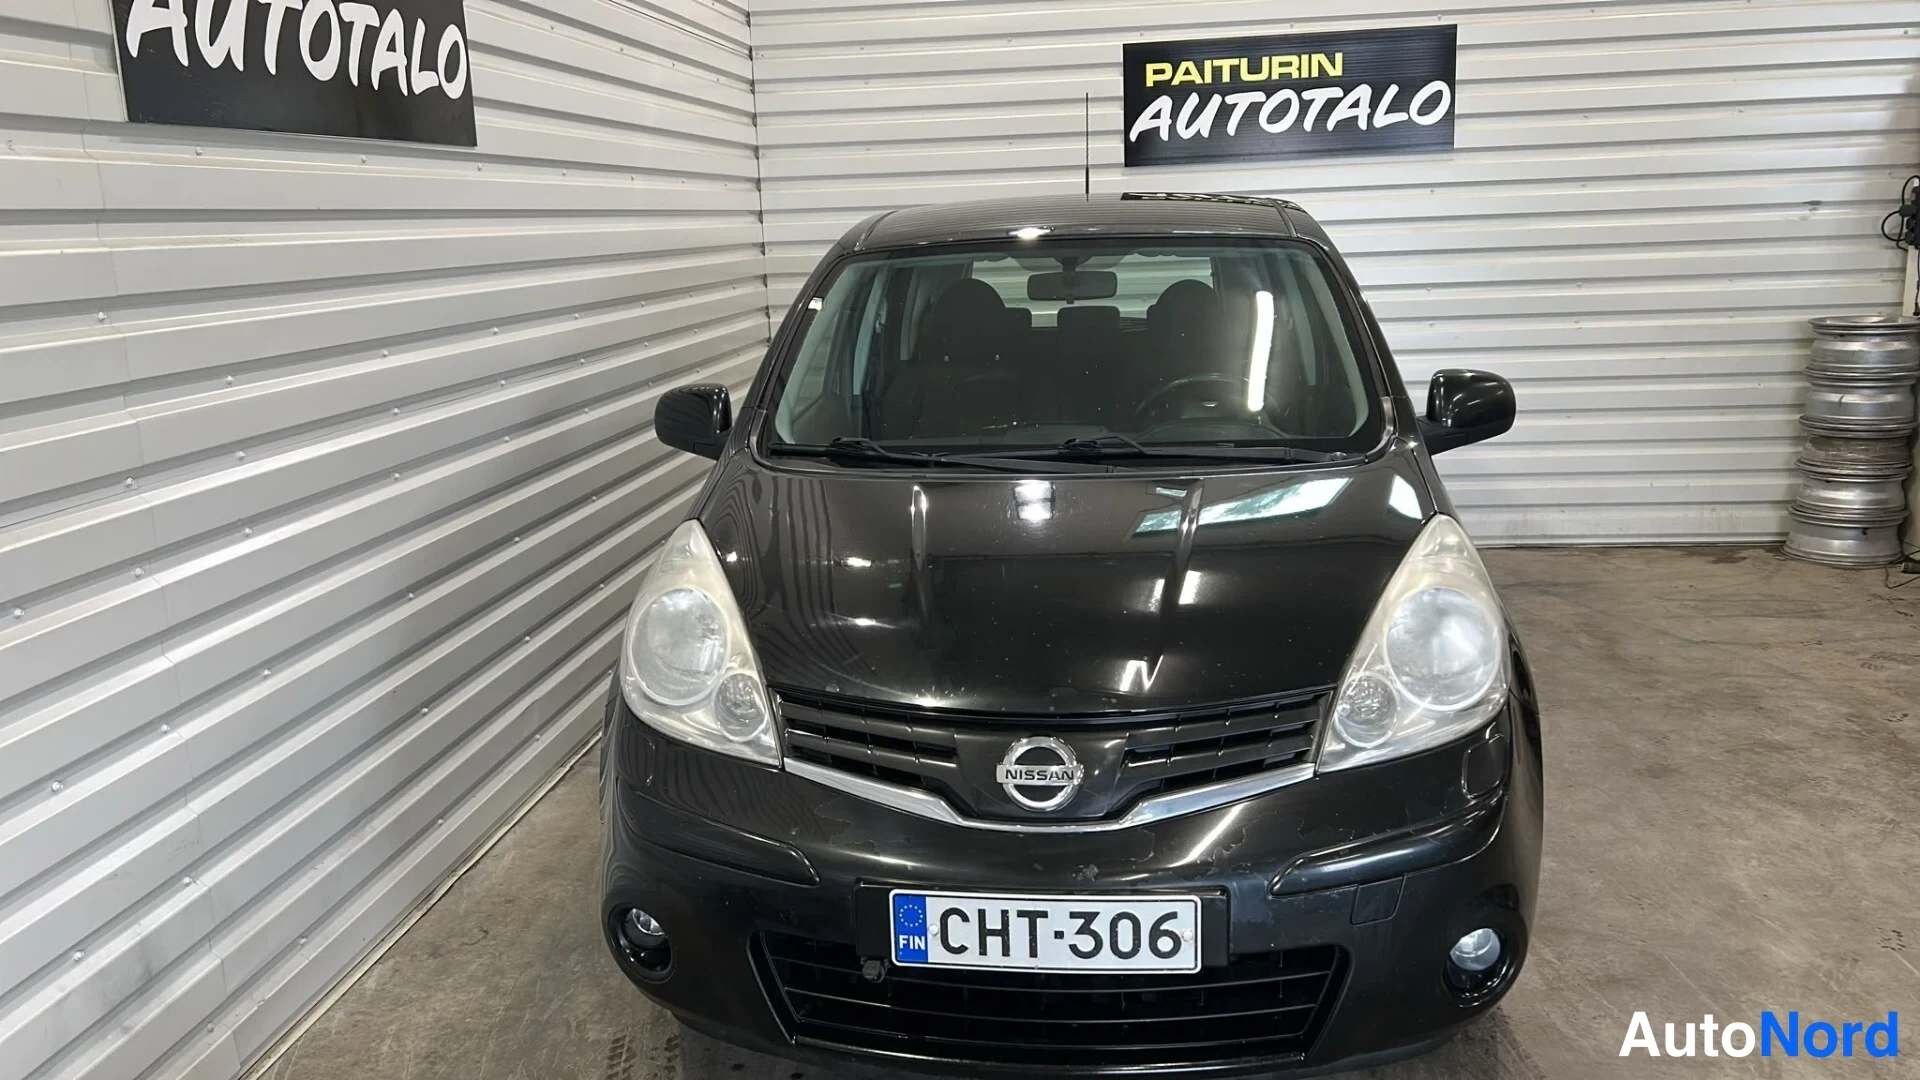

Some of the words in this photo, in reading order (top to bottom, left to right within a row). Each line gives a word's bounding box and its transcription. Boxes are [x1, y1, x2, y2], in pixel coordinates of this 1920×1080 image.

[126, 0, 467, 99] AUTOTALO
[1145, 52, 1343, 87] PAITURIN
[1129, 80, 1451, 142] AUTOTALO
[1005, 769, 1074, 781] NISSAN
[899, 935, 925, 950] FIN
[939, 907, 1182, 960] CHT-306
